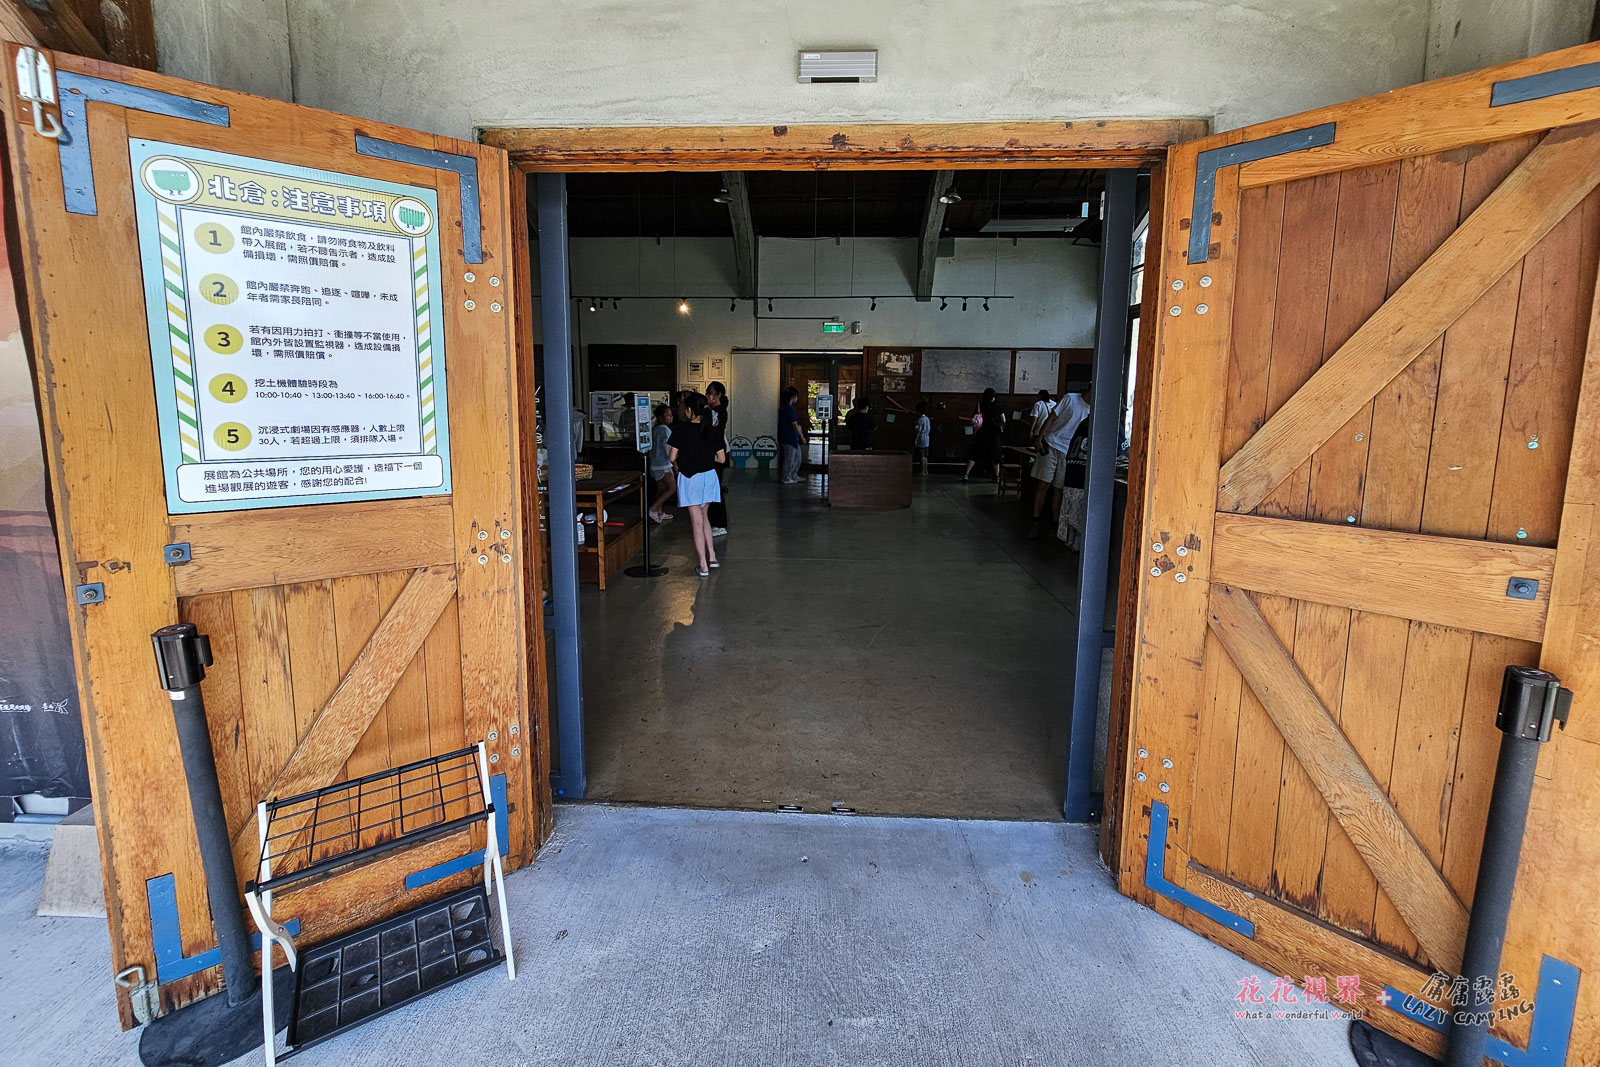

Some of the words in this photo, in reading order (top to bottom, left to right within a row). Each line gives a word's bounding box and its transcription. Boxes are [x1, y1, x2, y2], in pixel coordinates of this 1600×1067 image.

[208, 230, 222, 247] 1
[212, 281, 227, 298] 2
[247, 292, 331, 308] 年者需家長陪同。
[217, 331, 231, 348] 3
[221, 381, 236, 396] 4
[254, 378, 338, 389] 挖土機體驗時段為
[226, 428, 240, 445] 5
